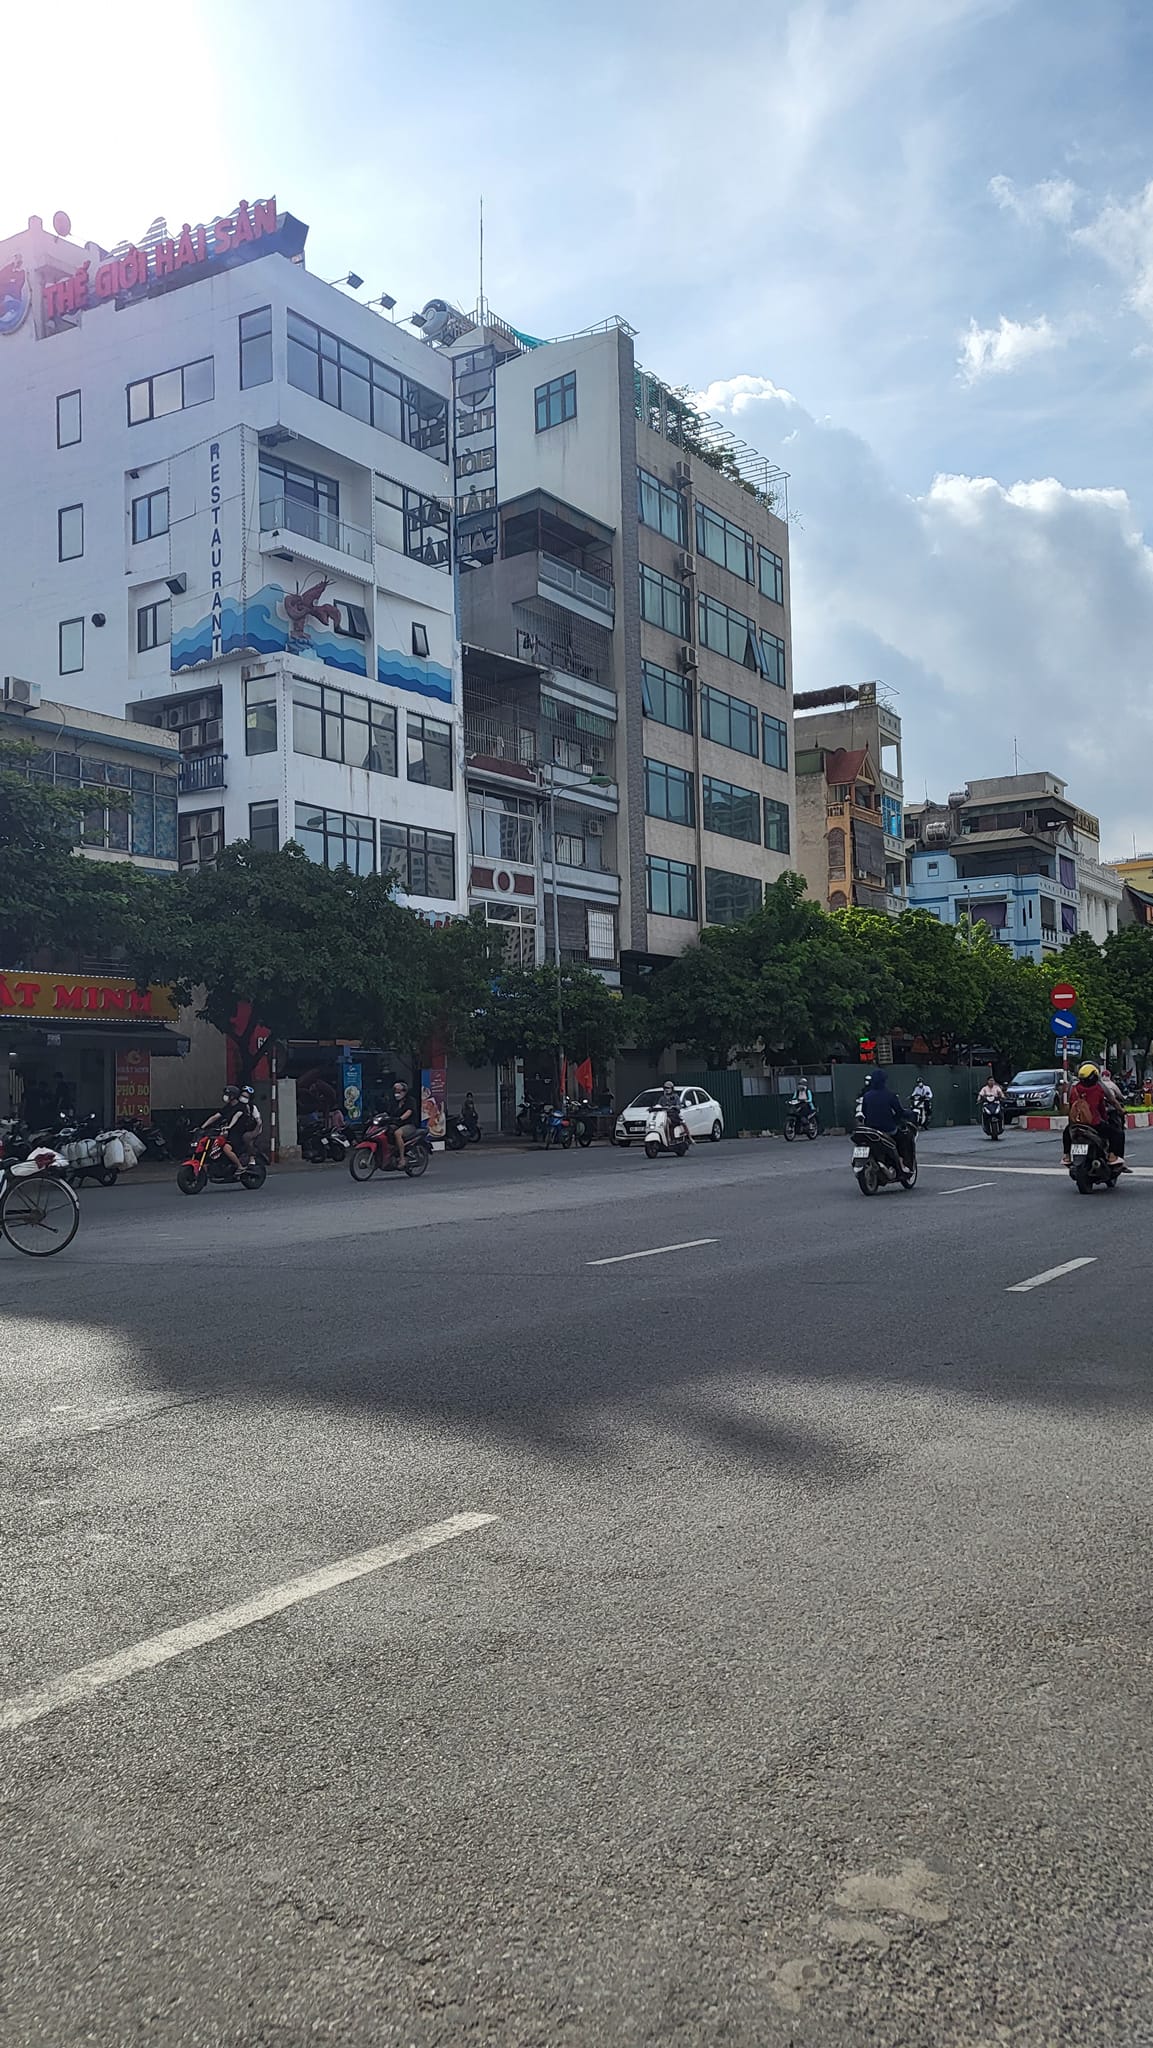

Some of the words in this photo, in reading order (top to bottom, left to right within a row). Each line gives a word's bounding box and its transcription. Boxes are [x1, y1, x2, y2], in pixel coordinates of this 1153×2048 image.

[44, 260, 90, 318] THẾ
[155, 223, 206, 277] HẢI
[214, 199, 277, 254] SẢN
[209, 442, 223, 653] RESTAURANT
[53, 984, 152, 1012] MINH
